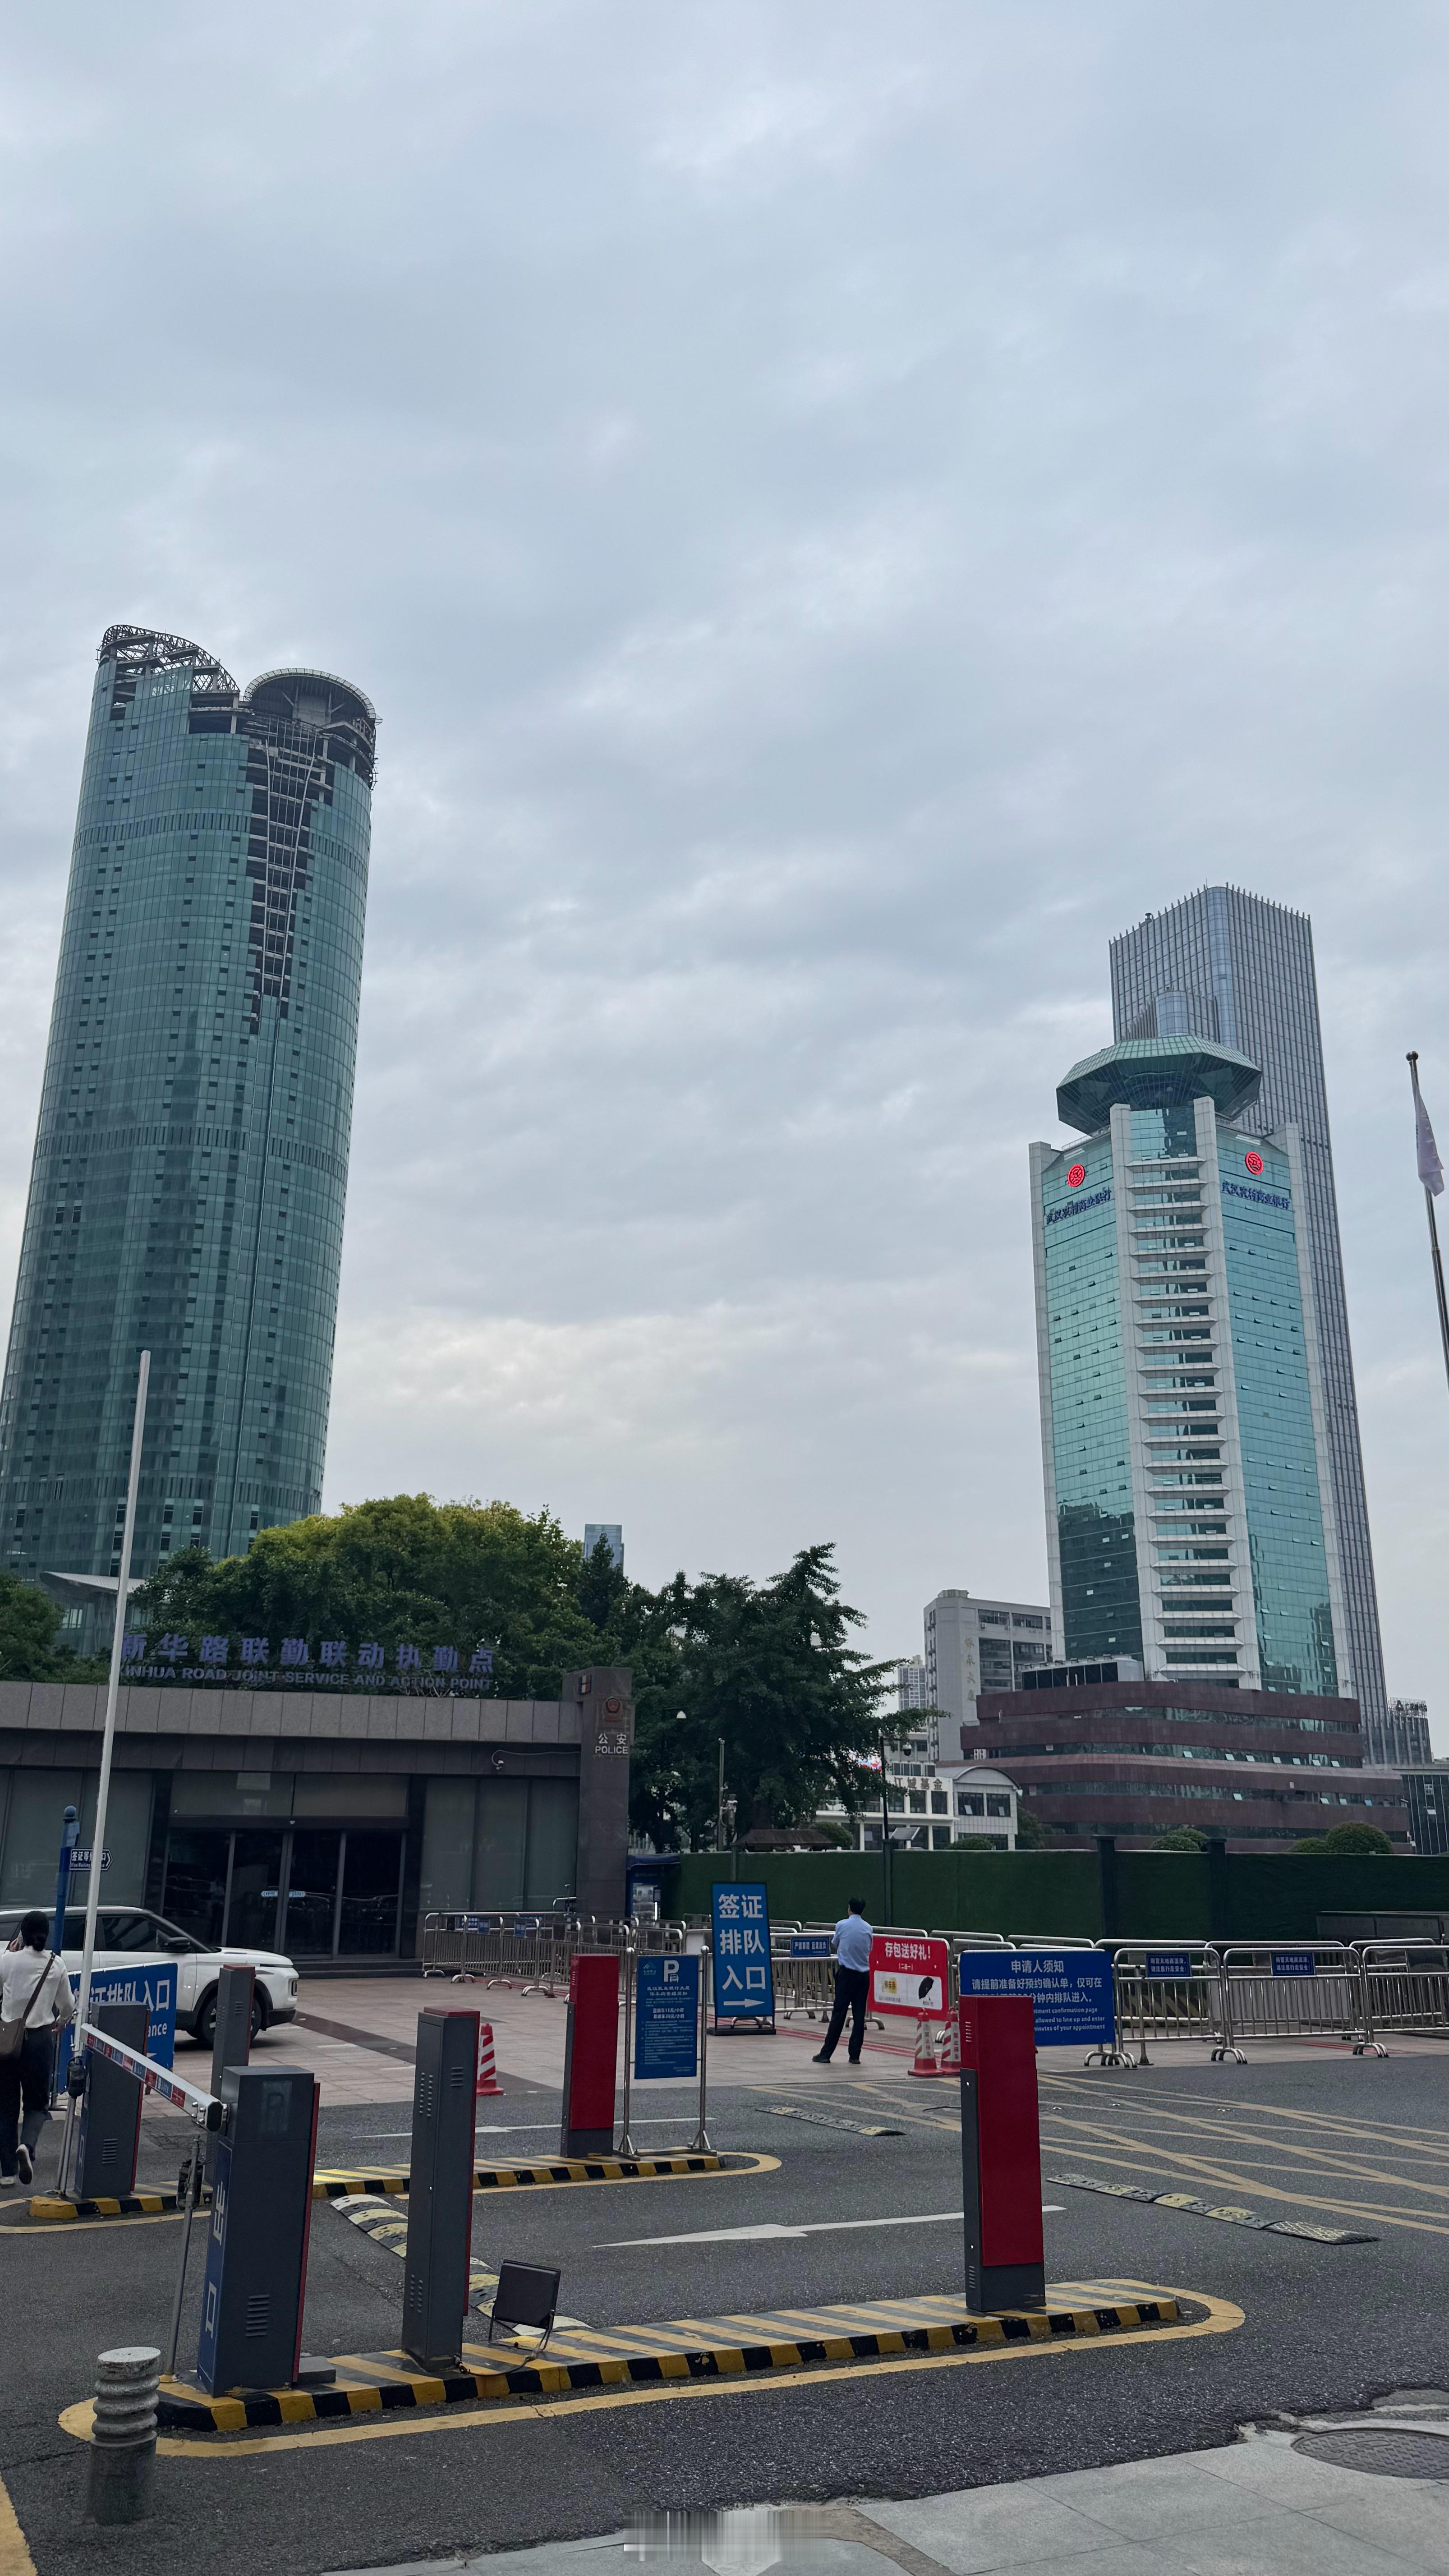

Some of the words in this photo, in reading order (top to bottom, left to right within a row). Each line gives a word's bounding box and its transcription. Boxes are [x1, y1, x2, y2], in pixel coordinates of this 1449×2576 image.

[120, 1633, 494, 1674] 新华路联勤联动执勤点
[182, 1667, 227, 1680] ROAD
[232, 1669, 280, 1683] JOINT
[285, 1671, 350, 1685] SERVICE
[354, 1674, 385, 1686] AND
[391, 1676, 445, 1688] ACTION
[451, 1678, 493, 1689] POINT
[594, 1746, 629, 1754] POLICE
[598, 1733, 627, 1745] 公安
[718, 1894, 764, 1919] 签证
[720, 1929, 765, 1955] 排队
[722, 1965, 766, 1991] 入口
[1011, 1960, 1064, 1973] 申请人须知
[206, 2181, 225, 2339] 出口
